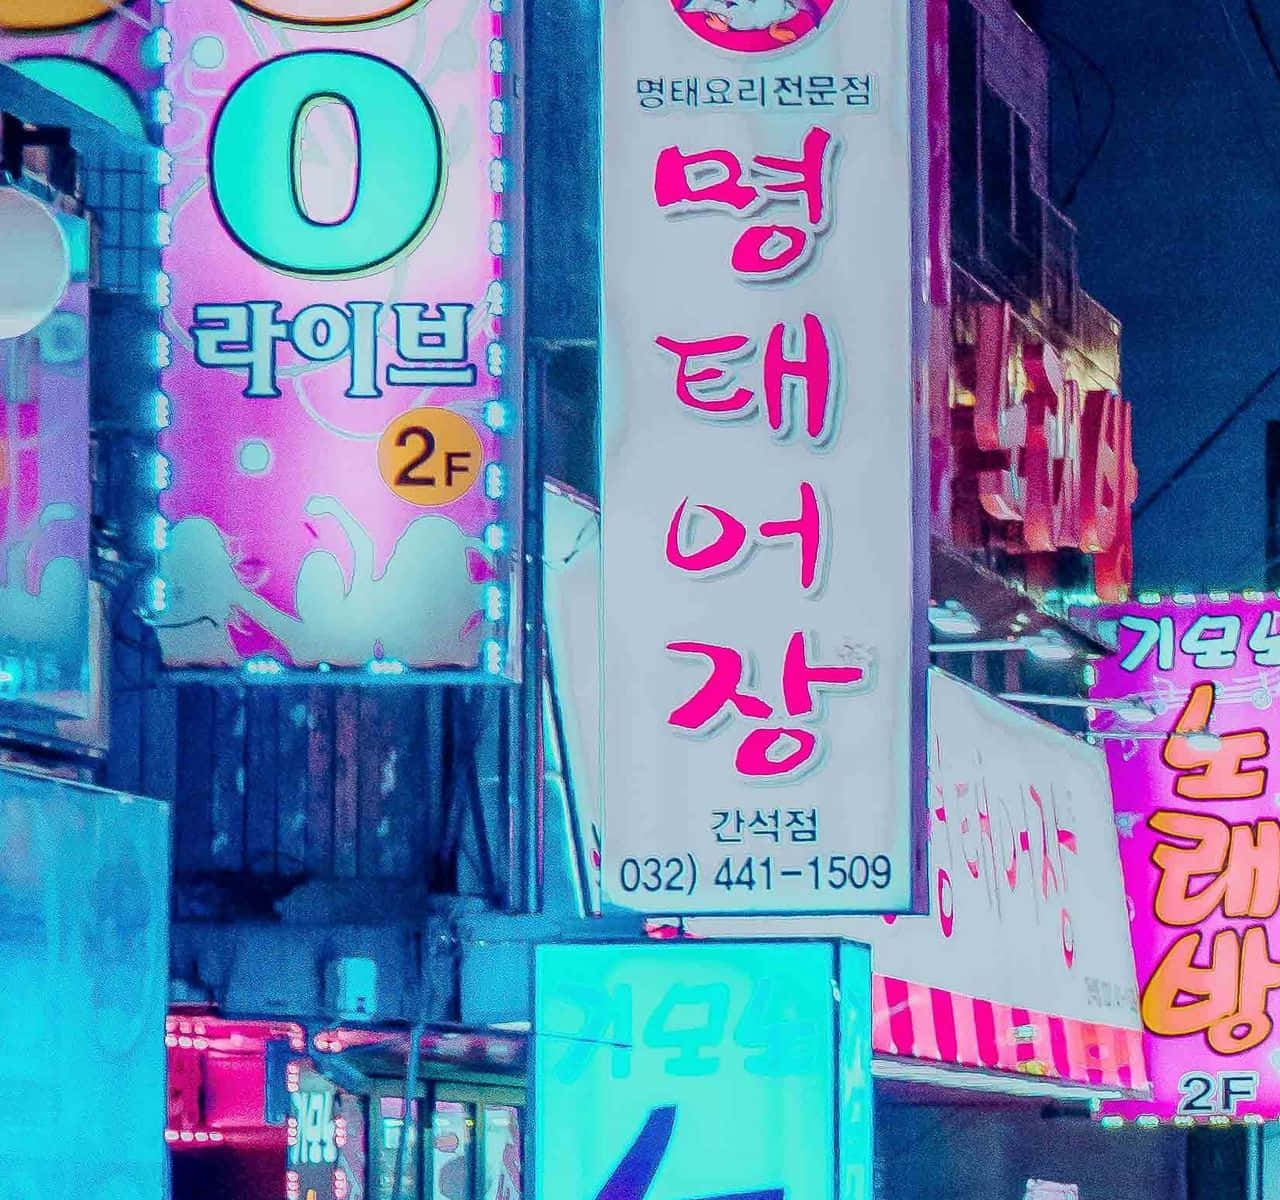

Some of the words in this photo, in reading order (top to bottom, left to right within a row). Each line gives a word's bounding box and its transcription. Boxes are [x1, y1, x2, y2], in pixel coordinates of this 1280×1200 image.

[635, 74, 873, 110] 명태요리전문점
[208, 0, 446, 280] 0
[194, 301, 476, 398] 라이브
[393, 426, 471, 487] 2F
[653, 126, 863, 778] 명태어장
[712, 809, 819, 843] 간석점
[619, 857, 698, 897] 032)
[713, 854, 893, 893] 441-1509
[1179, 1073, 1260, 1114] 2F
